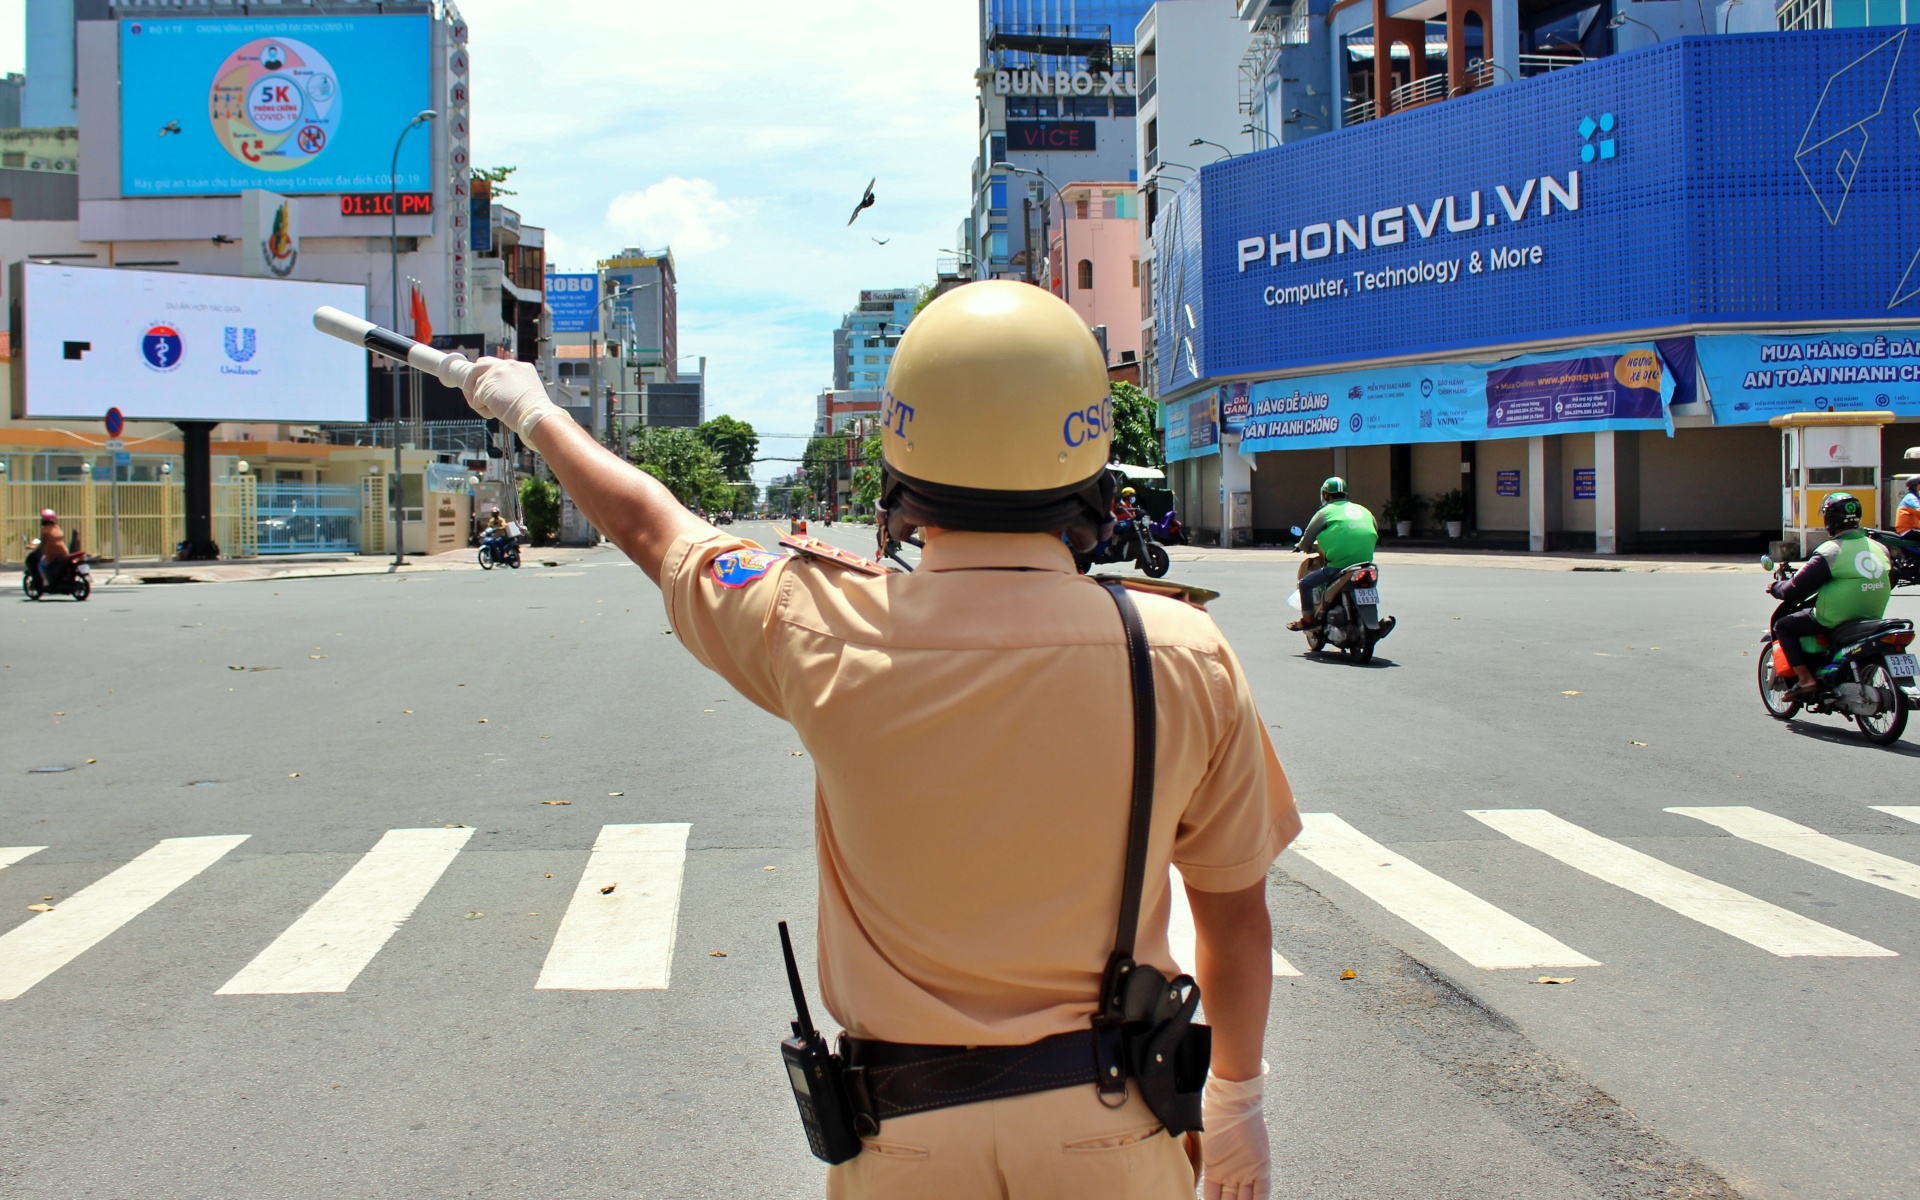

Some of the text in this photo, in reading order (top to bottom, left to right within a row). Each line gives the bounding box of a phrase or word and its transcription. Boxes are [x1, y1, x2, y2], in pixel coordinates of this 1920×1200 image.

[995, 63, 1049, 95] BÚN
[1055, 63, 1093, 95] BÒ
[1024, 125, 1079, 146] VICE
[402, 195, 431, 213] PM
[1237, 170, 1579, 272] PHONGVU.VN
[1264, 245, 1543, 306] Computer, Technology & More
[872, 292, 906, 300] SeABank
[1761, 343, 1802, 362] MUA
[1806, 341, 1859, 360] HÀNG
[1861, 336, 1886, 359] DỄ
[1537, 371, 1610, 386] www.phongvu.vn
[1743, 371, 1771, 388] AN
[1776, 365, 1827, 386] TOÀN
[1830, 366, 1897, 383] NHANH
[1861, 581, 1884, 591] gojek
[1890, 655, 1913, 666] 53-P6
[1894, 665, 1915, 676] 2407
